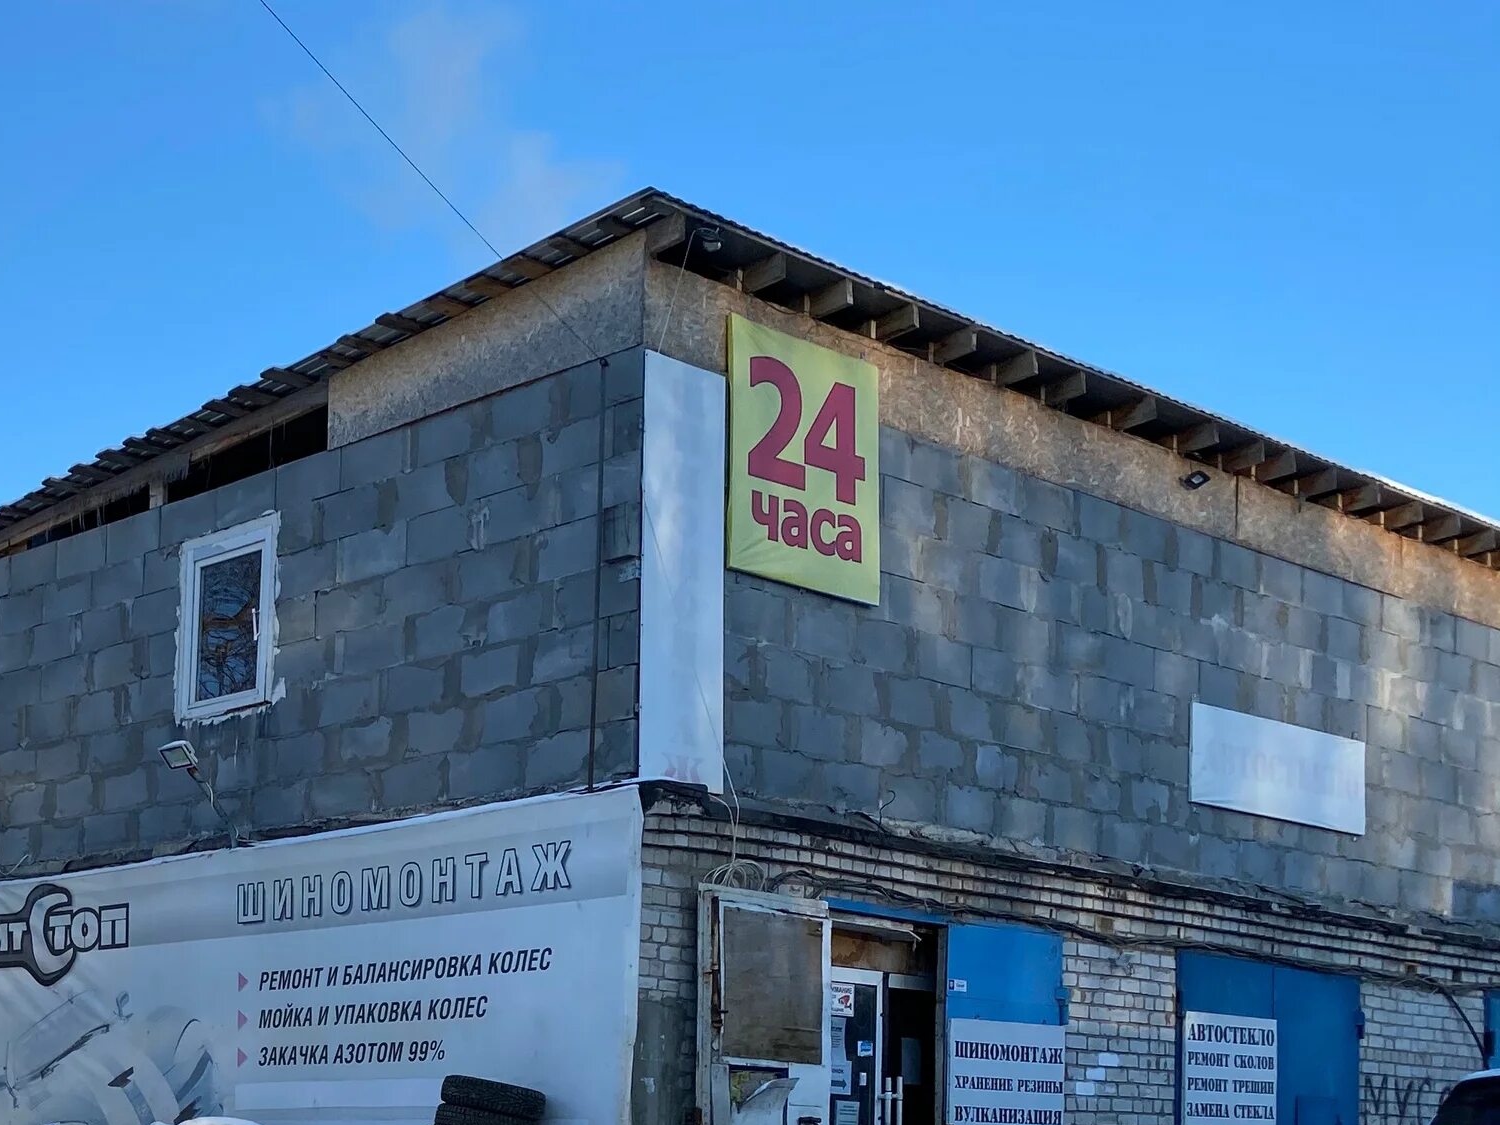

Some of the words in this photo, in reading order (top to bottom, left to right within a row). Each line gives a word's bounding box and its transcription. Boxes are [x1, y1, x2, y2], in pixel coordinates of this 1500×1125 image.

[748, 356, 865, 506] 24
[752, 489, 862, 564] часа
[236, 840, 572, 924] ШИНОМОНТАЖ
[258, 967, 323, 992] РЕМОНТ
[326, 966, 339, 987] И
[341, 953, 482, 987] БАЛАНСИРОВКА
[487, 947, 553, 975] КОЛЕС
[258, 1002, 313, 1029] МОЙКА
[317, 1005, 330, 1026] И
[333, 1000, 422, 1026] УПАКОВКА
[427, 995, 488, 1020] КОЛЕС
[1187, 1023, 1275, 1047] АВТОСТЕКЛО
[258, 1046, 328, 1067] ЗАКАЧКА
[333, 1041, 404, 1065] АЗОТОМ
[408, 1039, 445, 1063] 99%
[954, 1040, 1064, 1065] ШИНОМОНТАЖ
[1187, 1051, 1230, 1067] РЕМОНТ
[1234, 1054, 1275, 1070] СКОЛОВ
[954, 1075, 1013, 1092] ХРАНЕНИЕ
[1017, 1079, 1063, 1094] РЕЗИНЫ
[1187, 1077, 1228, 1093] РЕМОНТ
[954, 1105, 1062, 1125] ВУЛКАНИЗАЦИЯ
[1186, 1102, 1229, 1119] ЗАМЕНА
[1234, 1104, 1275, 1120] СТЕКЛА
